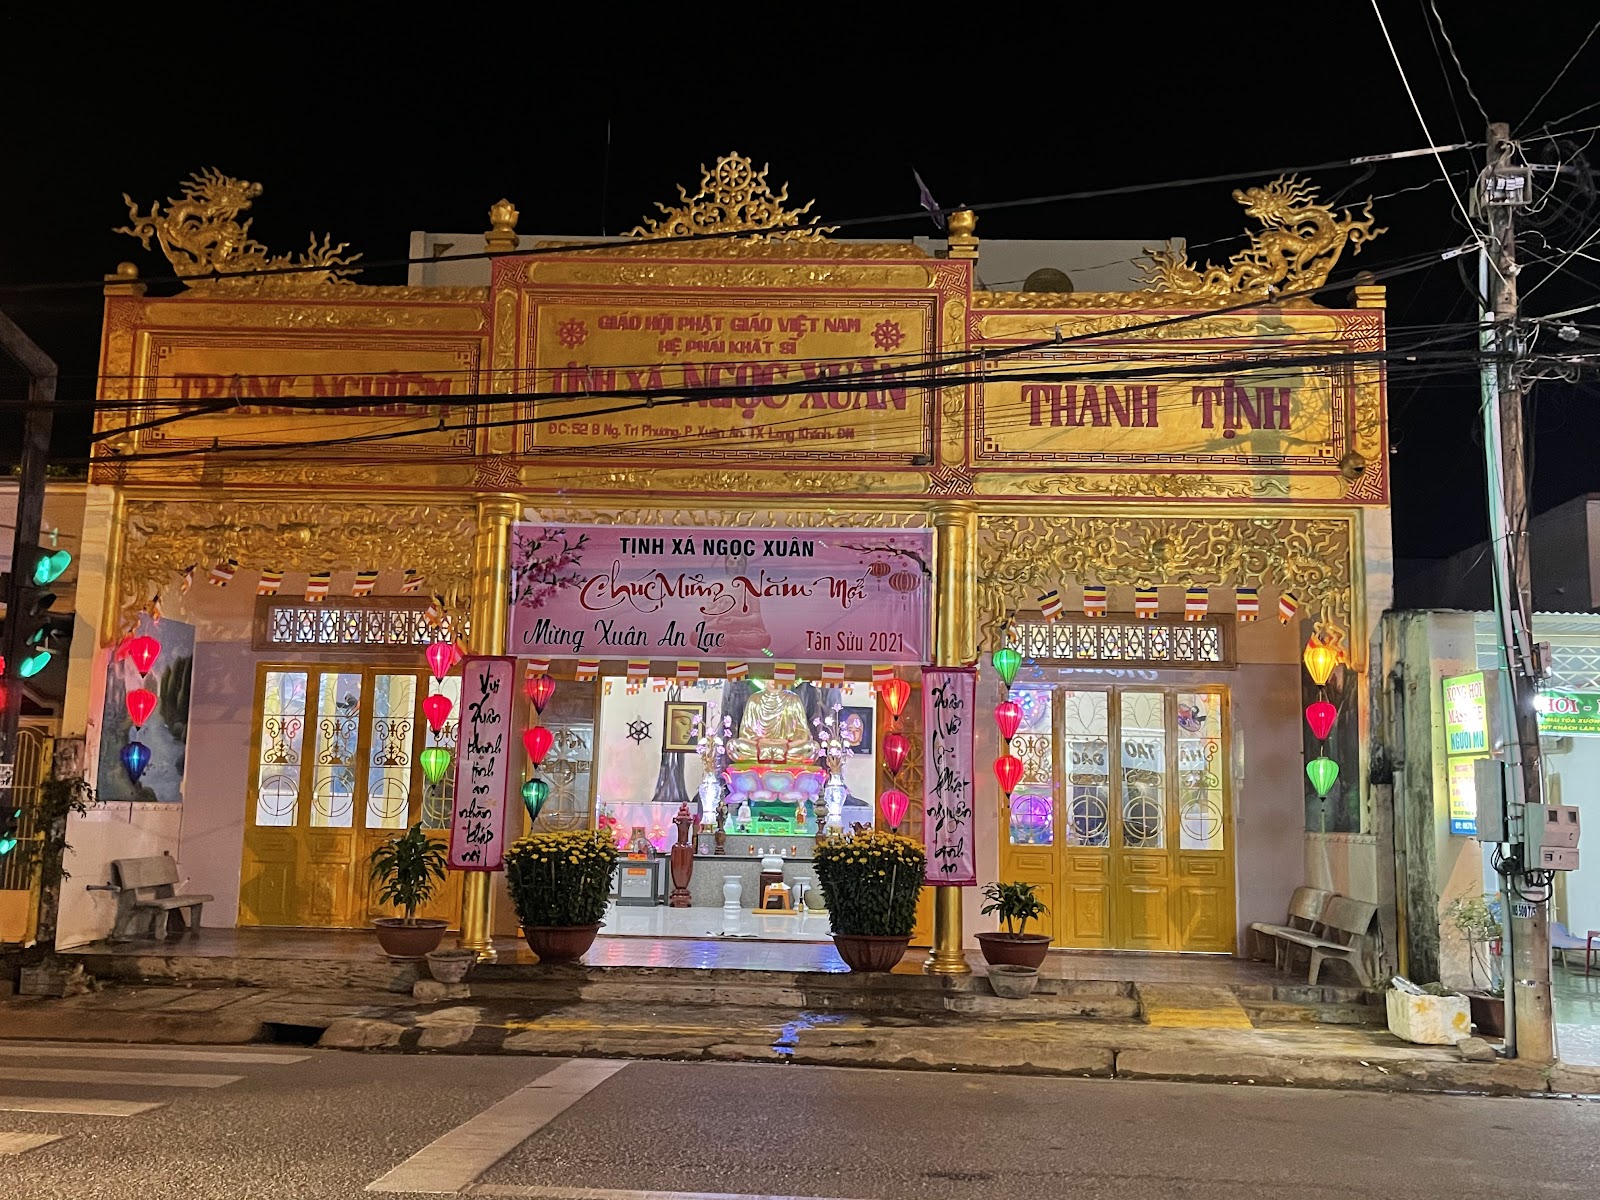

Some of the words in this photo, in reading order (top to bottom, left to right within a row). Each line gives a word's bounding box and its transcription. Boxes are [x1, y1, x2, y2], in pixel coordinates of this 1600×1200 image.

[598, 311, 641, 330] GIÁO
[645, 313, 674, 335] HỘI
[678, 314, 725, 335] PHẬT
[730, 312, 772, 332] GIÁO
[778, 314, 819, 337] VIỆT
[824, 318, 861, 332] NAM
[658, 336, 682, 356] HỆ
[686, 335, 726, 353] PHÁI
[729, 336, 774, 353] KHẤT
[683, 361, 789, 419] NGỌC
[801, 357, 907, 410] XUÂN
[1021, 385, 1159, 427] THANH
[1192, 379, 1291, 439] TỊNH
[592, 423, 600, 434] B
[620, 537, 664, 558] TỊNH
[671, 534, 696, 555] XÁ
[703, 539, 756, 560] NGỌC
[762, 536, 814, 557] XUÂN
[579, 558, 664, 613] Chúc
[731, 569, 812, 613] Năm
[523, 618, 585, 653] Mừng
[594, 619, 649, 646] Xuân
[657, 620, 687, 647] An
[806, 630, 831, 651] Tân
[836, 630, 863, 651] Sửu
[869, 631, 903, 653] 2021
